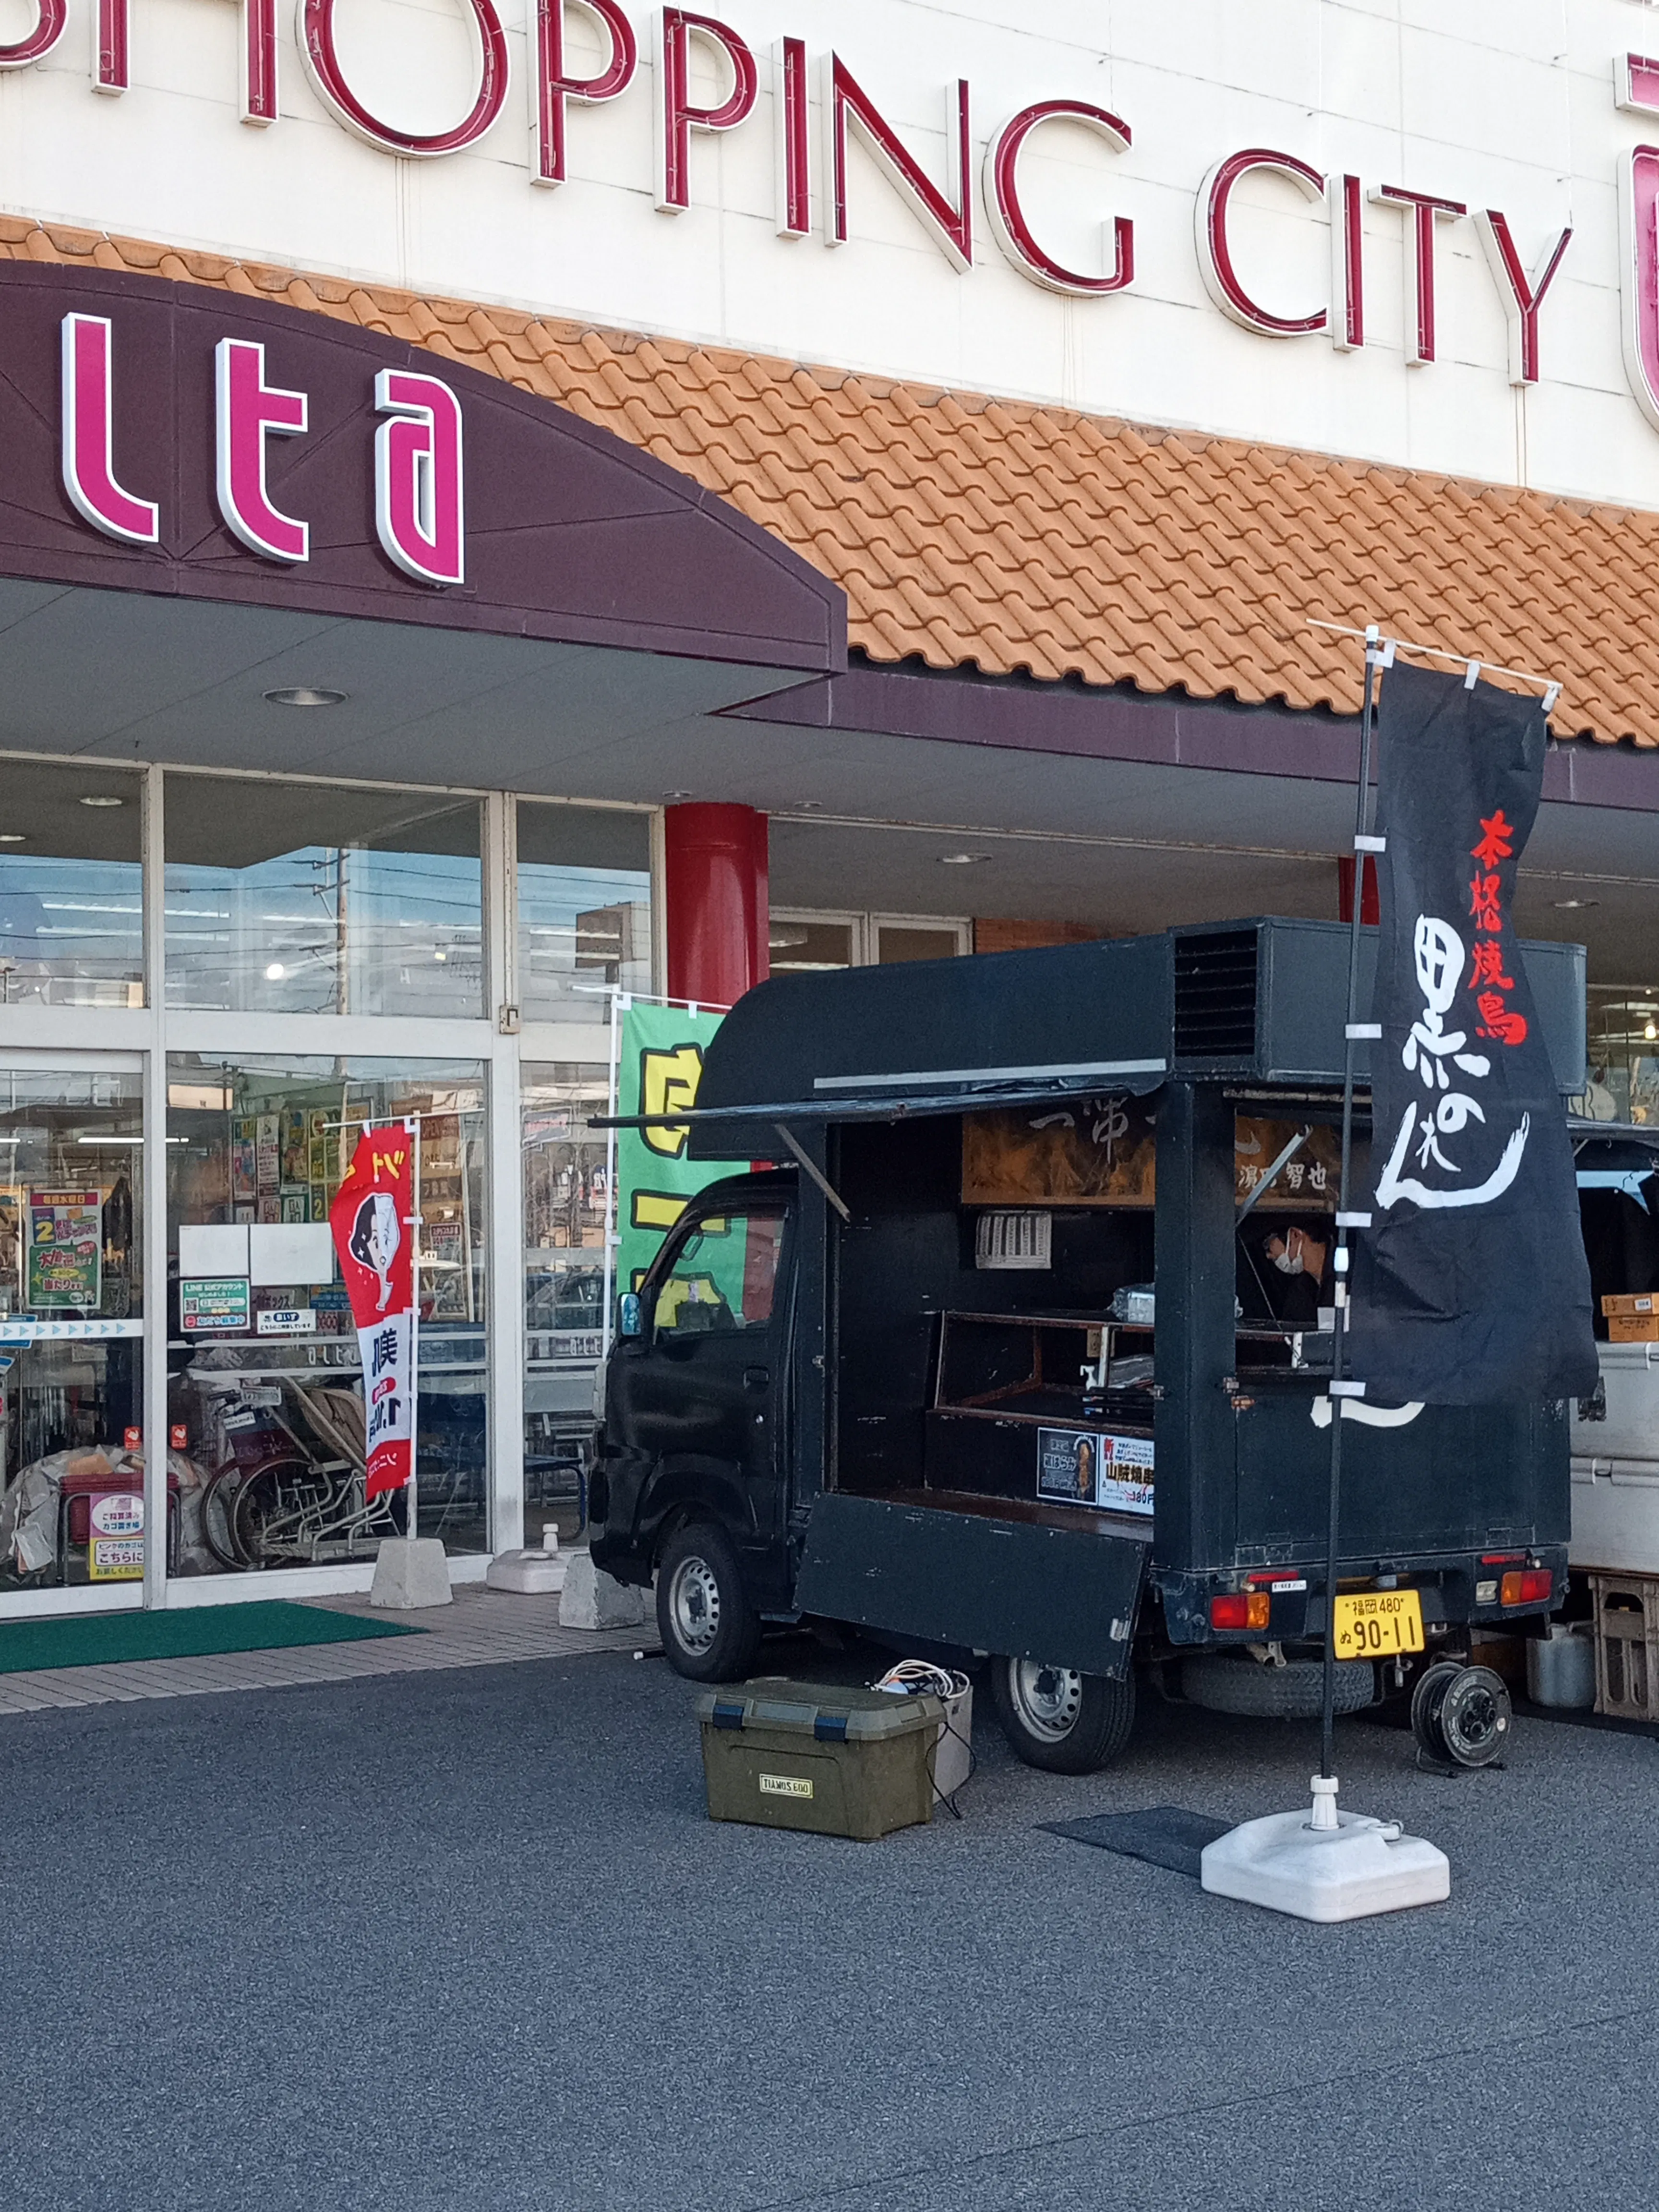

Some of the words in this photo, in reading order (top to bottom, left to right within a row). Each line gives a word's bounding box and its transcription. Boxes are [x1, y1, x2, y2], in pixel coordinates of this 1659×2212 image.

[1194, 148, 1574, 386] CITY
[1469, 809, 1527, 1046] 本格焼鳥
[35, 1221, 55, 1242] 2
[100, 1551, 144, 1563] こちらに
[1353, 1599, 1378, 1616] 福岡
[1379, 1598, 1401, 1614] 480
[1354, 1616, 1415, 1650] 90-11
